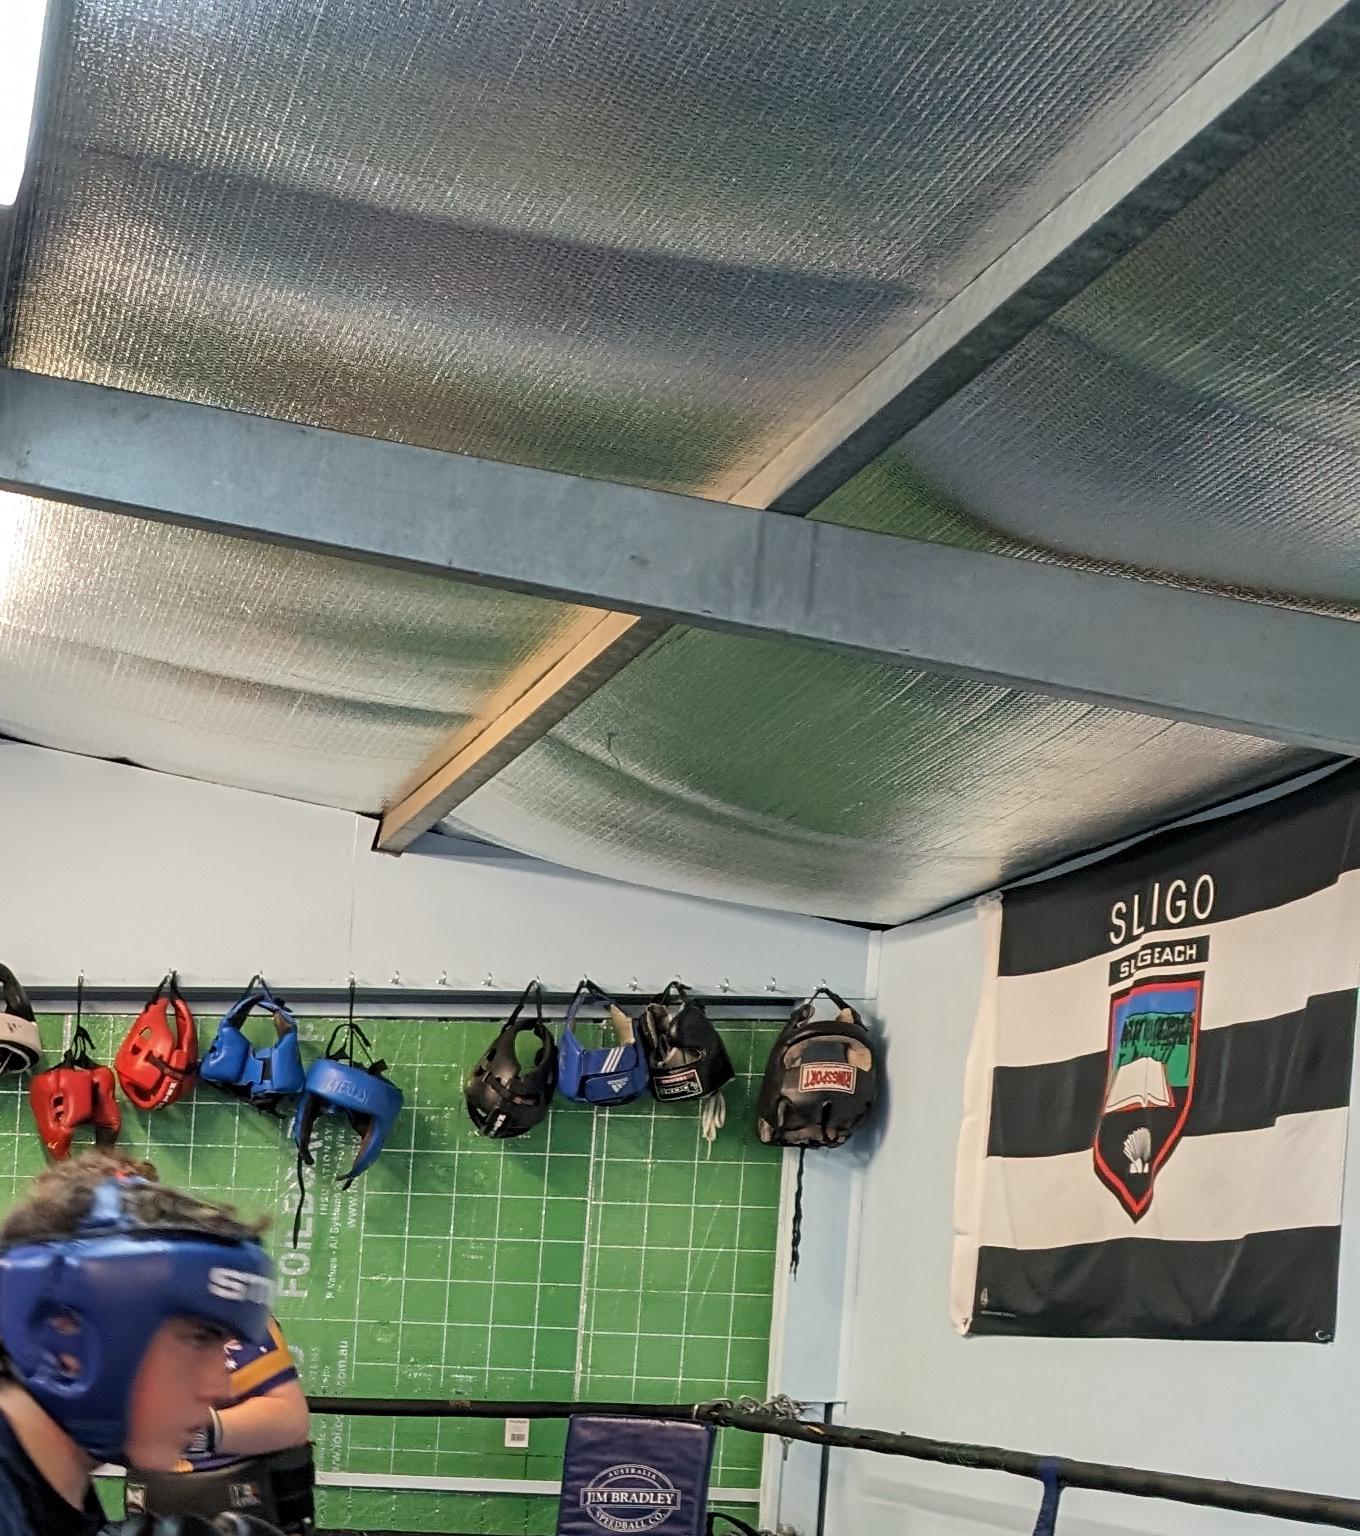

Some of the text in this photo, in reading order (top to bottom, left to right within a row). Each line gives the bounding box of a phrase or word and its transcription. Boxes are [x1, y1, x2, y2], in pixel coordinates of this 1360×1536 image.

[1109, 873, 1214, 945] SLIGO
[1119, 944, 1197, 978] SLGEACH
[608, 1467, 657, 1480] AUSTRALIA
[586, 1491, 675, 1505] JIM BRADLEY
[596, 1510, 645, 1530] SPEEDBALL
